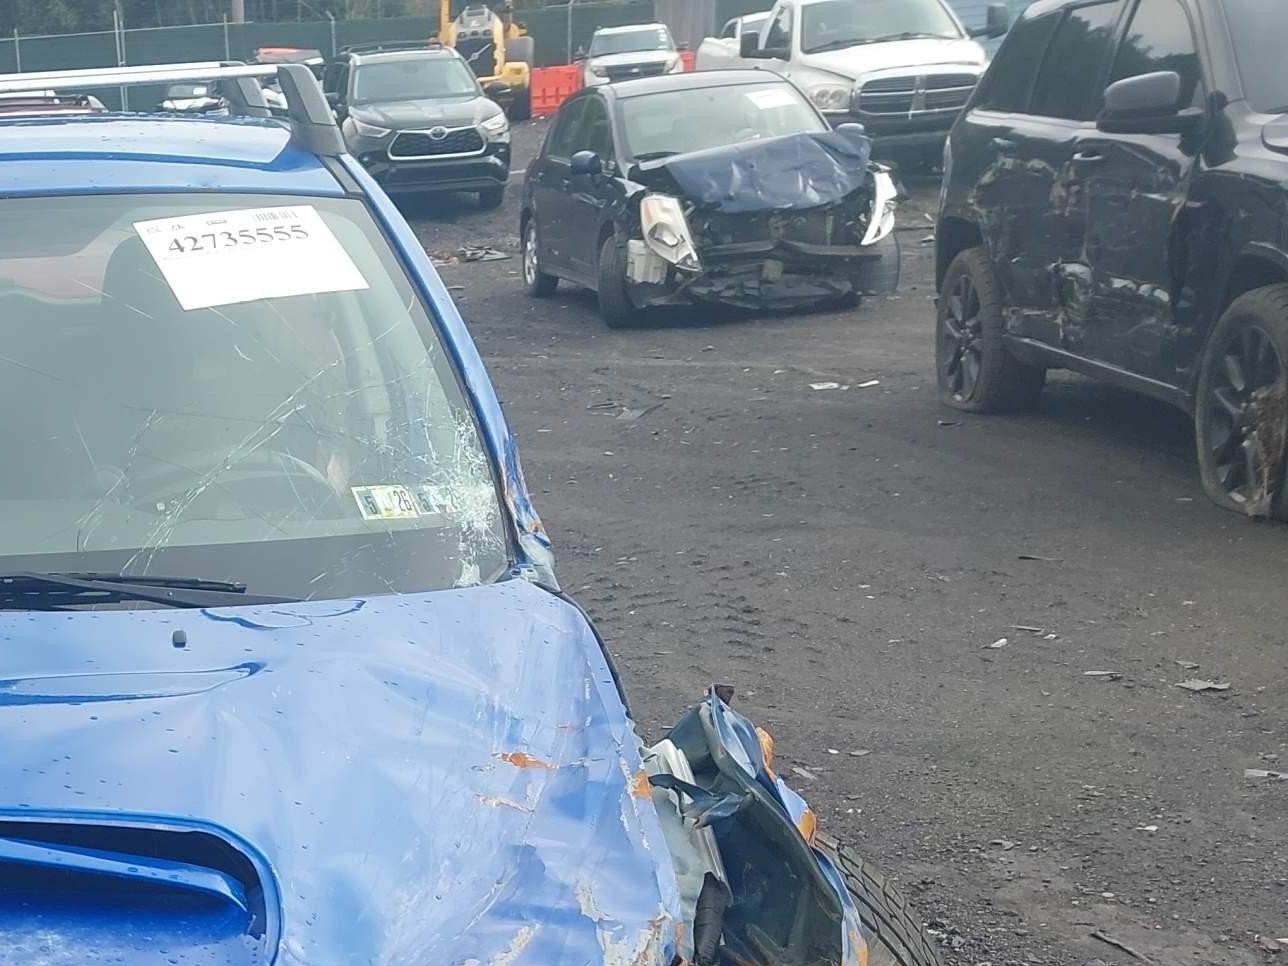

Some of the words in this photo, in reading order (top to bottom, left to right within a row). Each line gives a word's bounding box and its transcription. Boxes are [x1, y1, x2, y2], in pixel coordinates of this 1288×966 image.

[168, 224, 309, 253] 42735555
[363, 494, 378, 515] 5
[393, 489, 413, 512] 26
